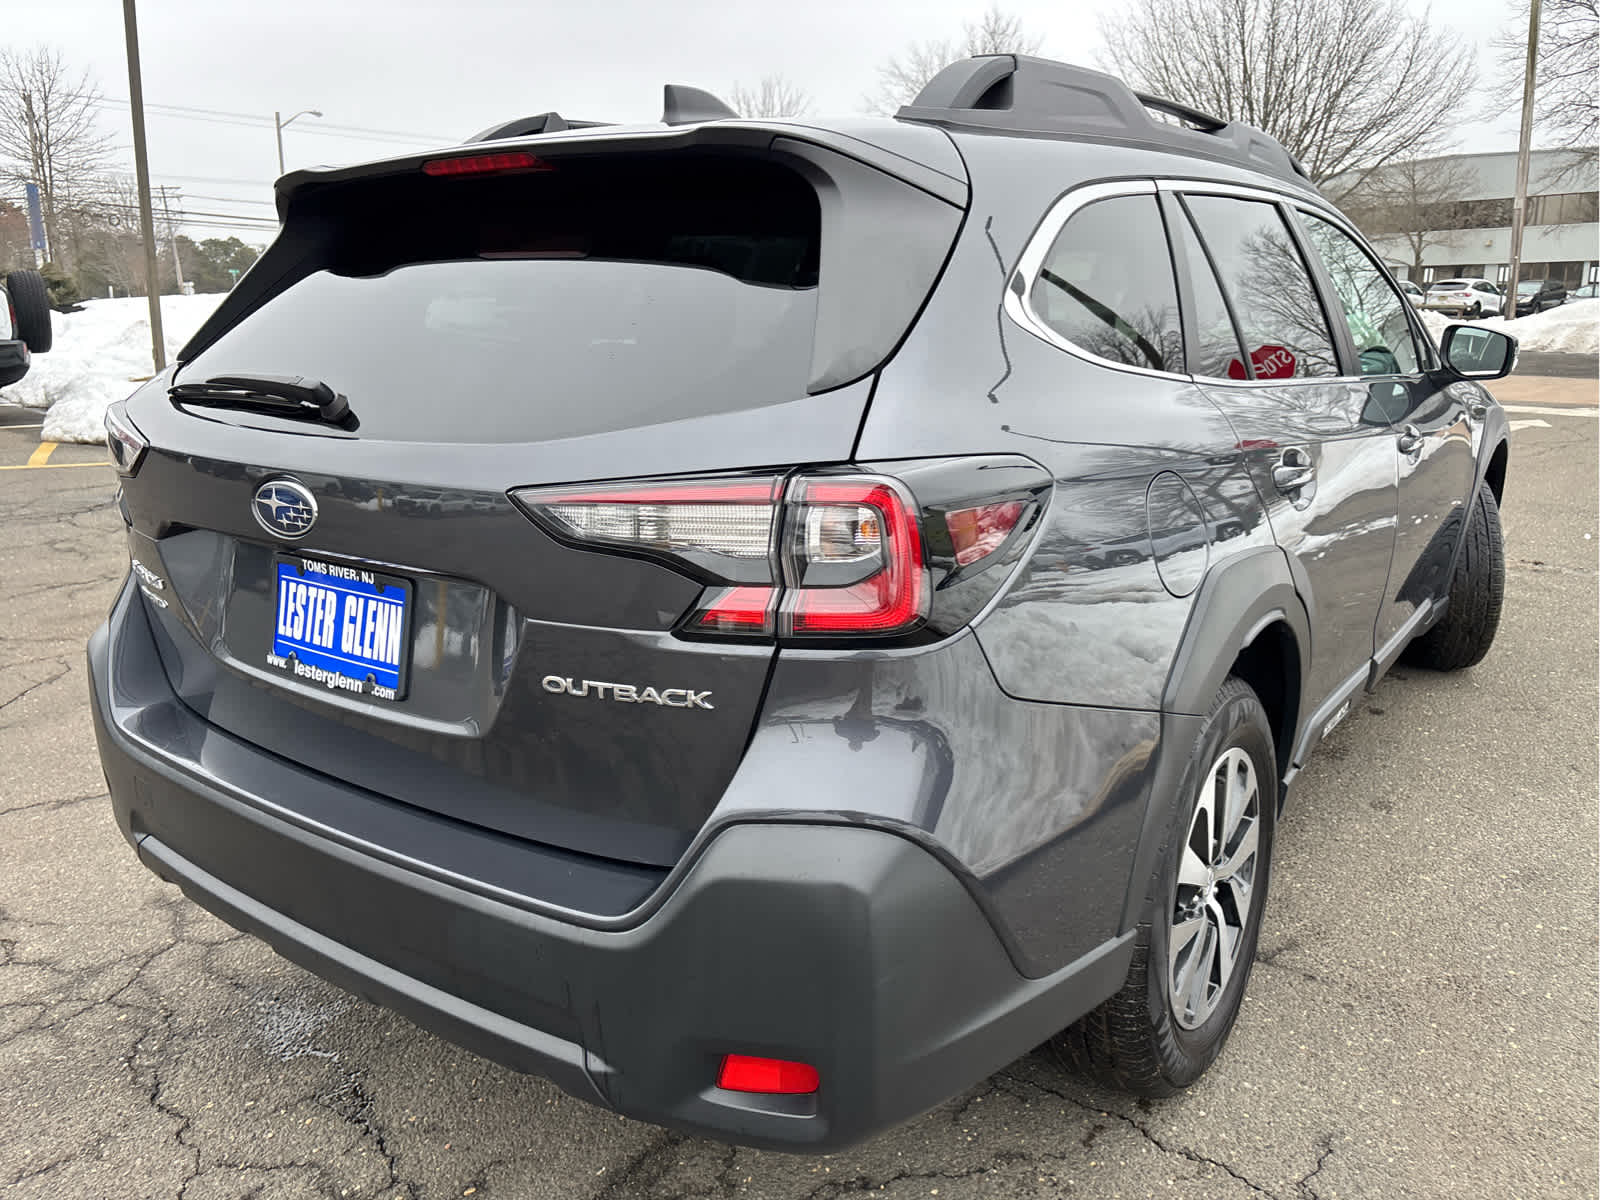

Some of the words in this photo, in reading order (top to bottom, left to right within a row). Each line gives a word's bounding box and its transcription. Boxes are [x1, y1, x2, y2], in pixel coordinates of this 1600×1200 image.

[302, 559, 327, 574] TOMS
[329, 565, 359, 581] RIVER,
[362, 572, 375, 585] NJ
[278, 580, 337, 649] LESTER
[341, 594, 403, 666] GLENN
[542, 675, 715, 710] OUTBACK
